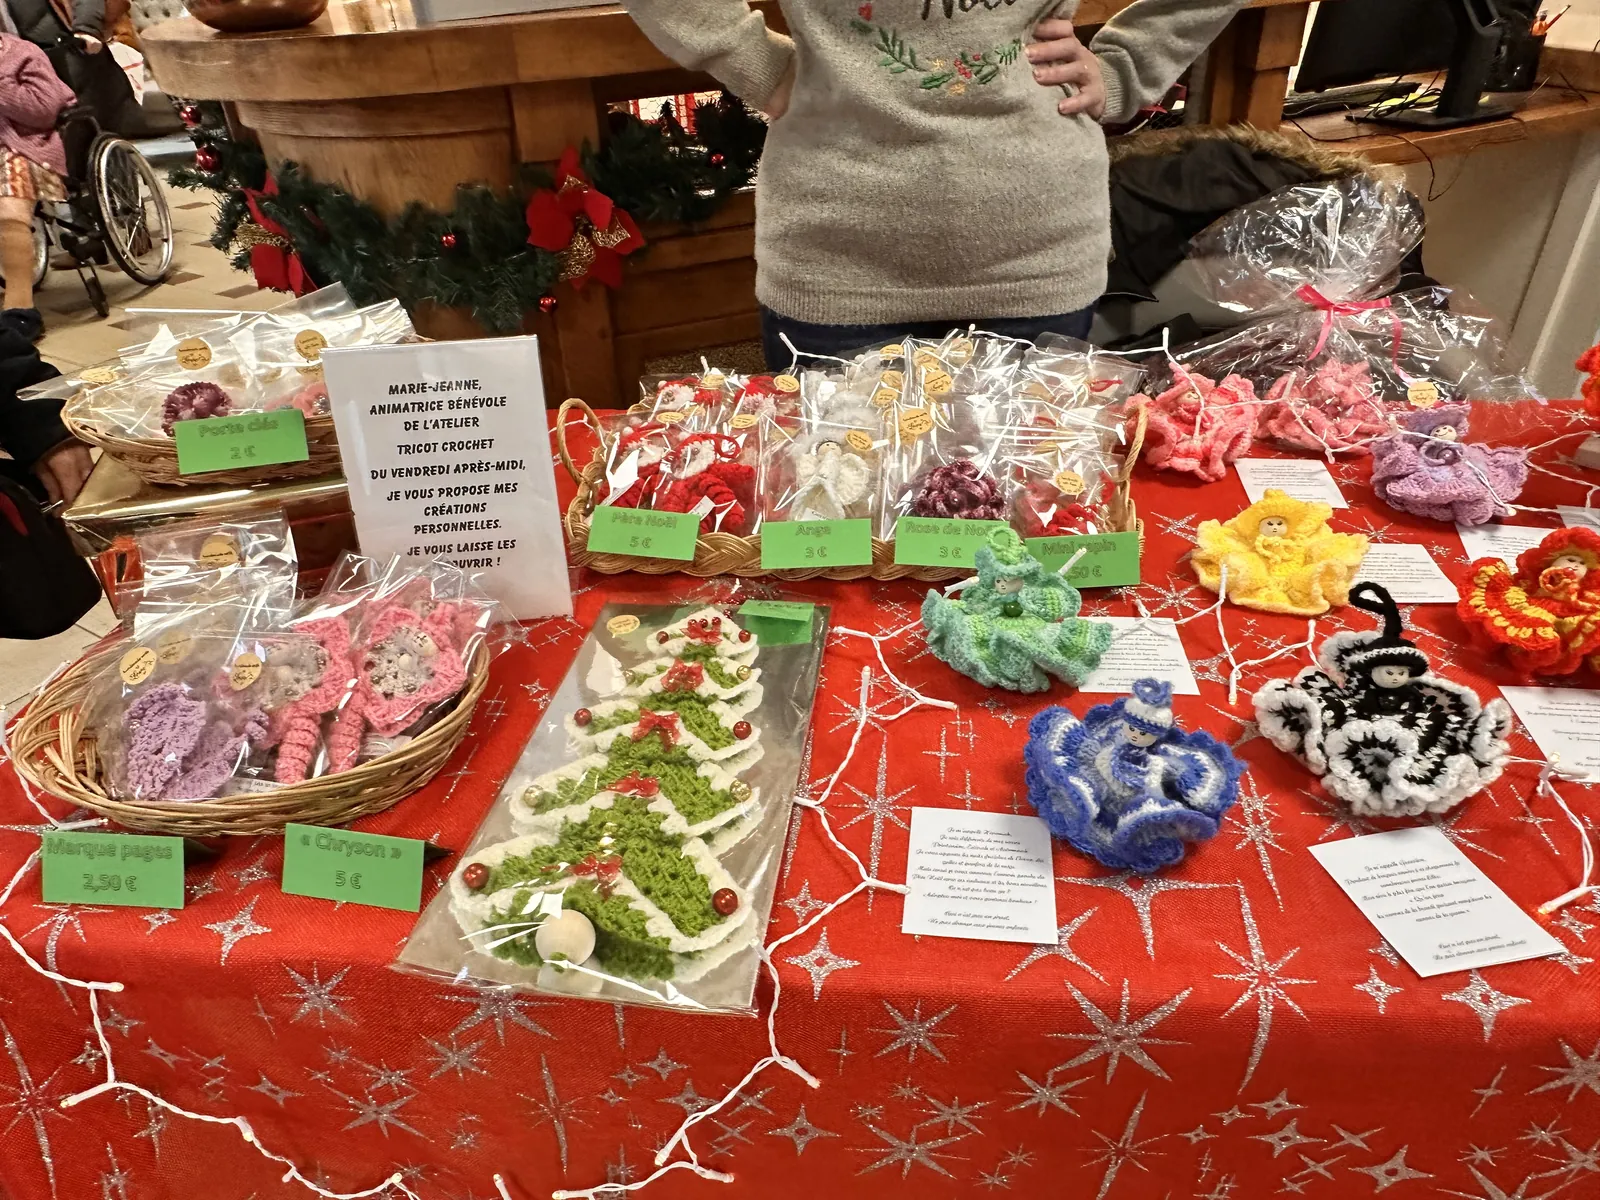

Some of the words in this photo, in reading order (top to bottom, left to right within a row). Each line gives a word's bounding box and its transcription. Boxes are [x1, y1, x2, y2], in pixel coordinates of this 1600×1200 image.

[388, 379, 482, 395] MARIE-JEANNE,
[369, 400, 443, 415] ANIMATRICE
[448, 396, 507, 410] BÉNÉVOLE
[198, 423, 244, 438] Porte
[404, 420, 419, 431] DE
[423, 416, 480, 430] L'ATELIER
[230, 446, 241, 460] 2
[244, 445, 256, 457] €
[397, 442, 438, 455] TRICOT
[442, 438, 494, 452] CROCHET
[370, 469, 387, 480] DU
[391, 464, 450, 478] VENDREDI
[453, 459, 526, 474] APRÈS-MIDI,
[386, 490, 401, 501] JE
[404, 488, 434, 500] VOUS
[438, 484, 490, 498] PROPOSE
[494, 482, 518, 494] MES
[424, 502, 487, 516] CRÉATIONS
[413, 519, 502, 535] PERSONNELLES.
[611, 511, 643, 525] Père
[644, 515, 678, 529] Noël
[795, 524, 831, 538] Ange
[905, 521, 940, 534] Rose
[942, 522, 961, 535] de
[406, 546, 420, 556] JE
[424, 544, 453, 555] VOUS
[456, 541, 494, 553] LAISSE
[497, 539, 516, 549] LES
[629, 536, 640, 548] 5
[641, 536, 652, 549] €
[1042, 540, 1075, 555] Mini
[805, 547, 814, 558] 3
[816, 546, 827, 558] €
[939, 546, 949, 558] 3
[951, 547, 962, 559] €
[496, 557, 501, 566] !
[1091, 565, 1102, 577] €
[46, 838, 116, 860] Marque
[121, 844, 173, 863] pages
[315, 832, 386, 858] Chryson
[83, 873, 122, 893] 2,50
[125, 875, 137, 892] €
[335, 870, 347, 887] 5
[350, 873, 362, 889] €
